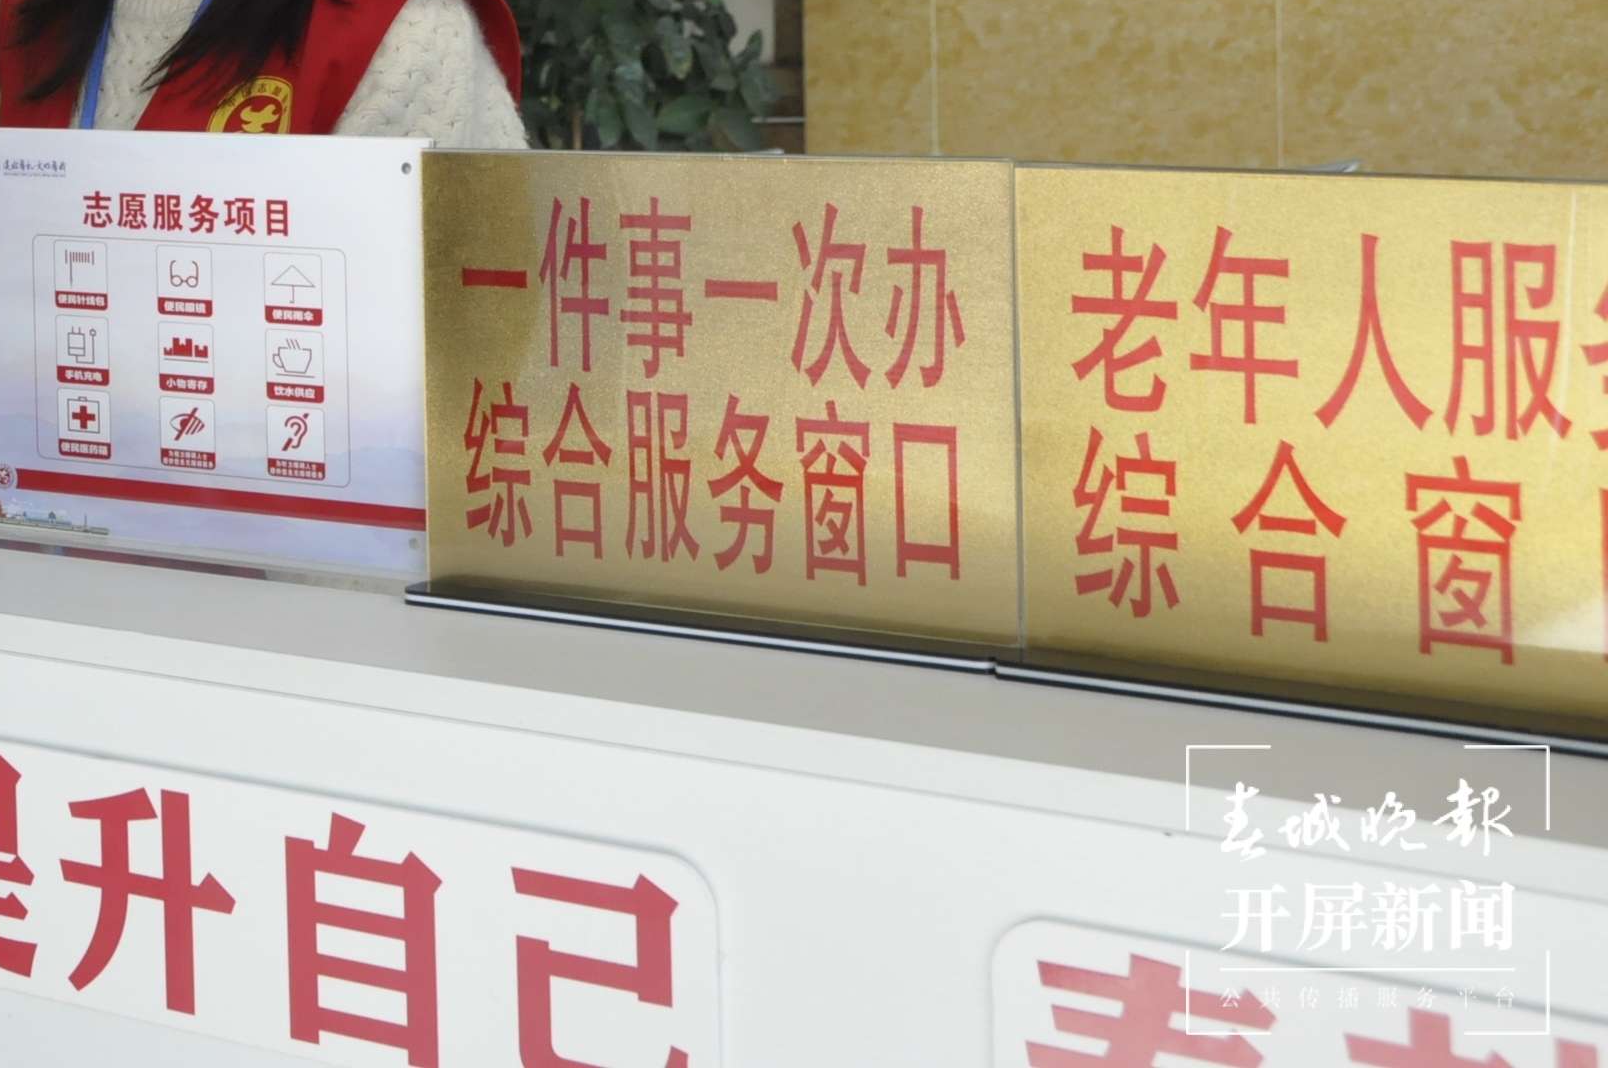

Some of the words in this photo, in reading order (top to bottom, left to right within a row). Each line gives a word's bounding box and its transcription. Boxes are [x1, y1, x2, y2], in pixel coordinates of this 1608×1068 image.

[83, 190, 290, 237] 志愿服务项目
[462, 196, 966, 390] 一件事一次办
[64, 369, 103, 383] 手机充电
[273, 385, 316, 400] 饮水供应
[1071, 224, 1608, 450] 老年人服
[463, 377, 961, 586] 综合服务窗口
[1072, 426, 1608, 666] 综合窗
